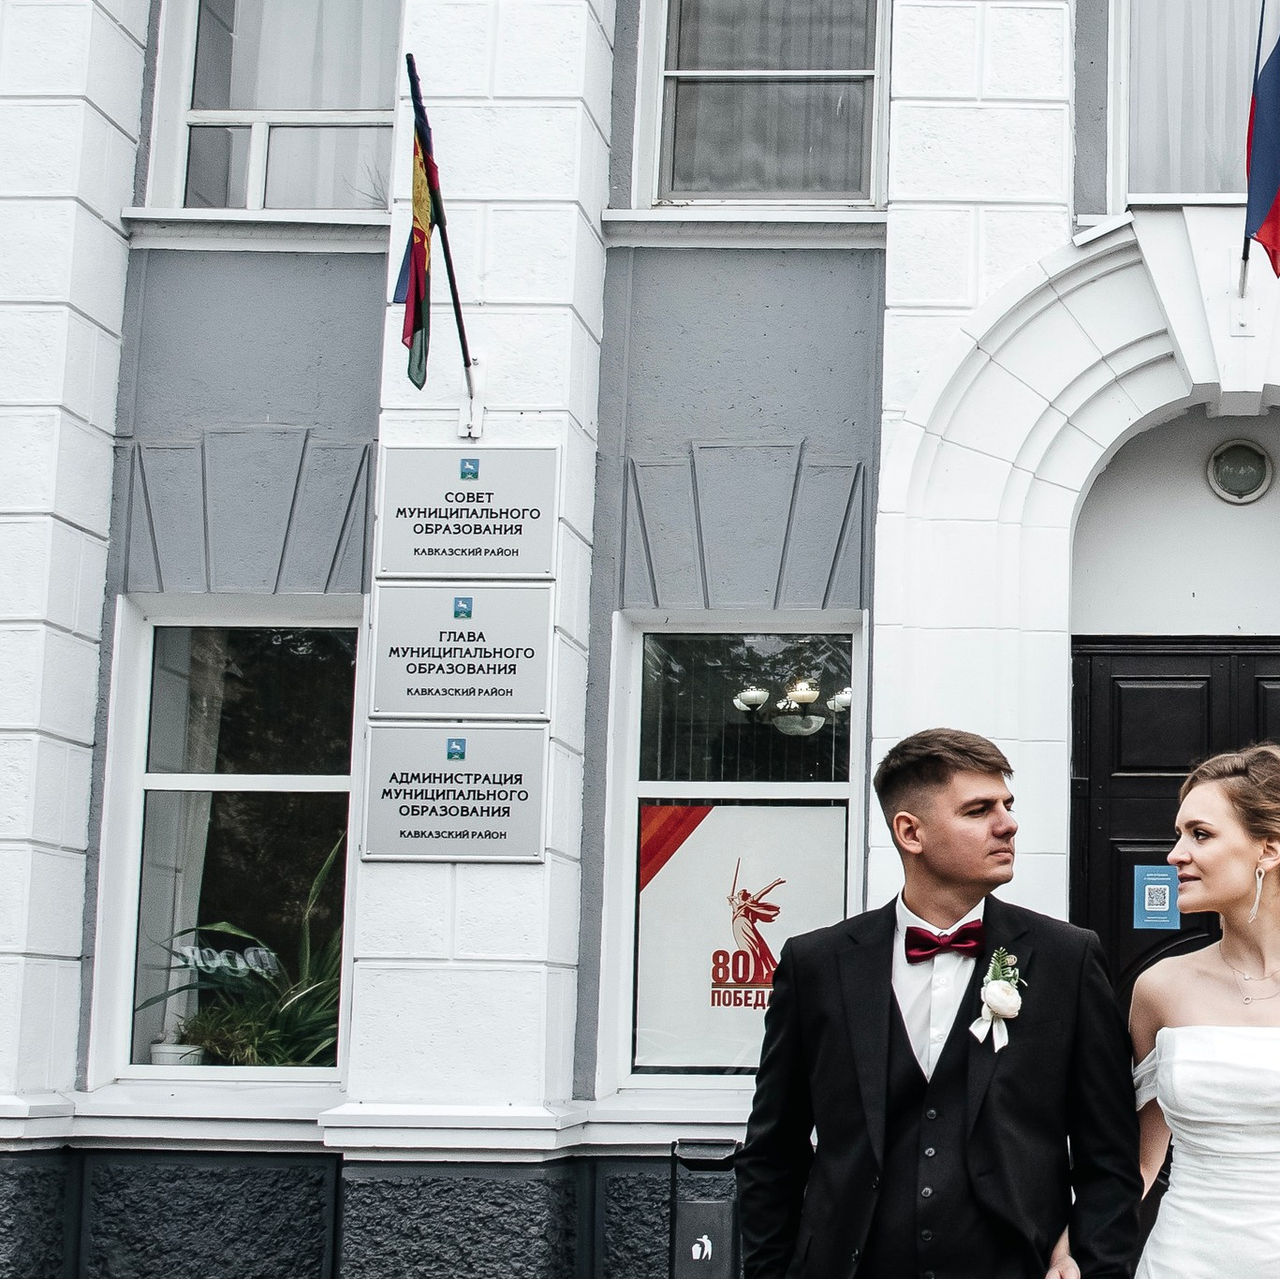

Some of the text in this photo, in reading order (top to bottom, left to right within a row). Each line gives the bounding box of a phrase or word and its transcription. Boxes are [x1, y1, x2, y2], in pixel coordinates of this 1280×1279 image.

[444, 491, 495, 504] СОВЕТ
[395, 507, 541, 520] МУНИЦИПАЛЬНОГО
[412, 523, 523, 536] ОБРАЗОВАНИЯ
[413, 546, 519, 557] КАВКАЗСКИЙ РАЙОН
[439, 631, 486, 643] ГЛАВА
[388, 646, 535, 660] МУНИЦИПАЛЬНОГО
[406, 662, 517, 675] ОБРАЗОВАНИЯ
[406, 686, 513, 697] КАВКАЗСКИЙ РАЙОН
[388, 772, 523, 787] АДМИНИСТРАЦИЯ
[380, 788, 529, 802] МУНИЦИПАЛЬНОГО
[398, 804, 511, 818] ОБРАЗОВАНИЯ
[399, 829, 507, 840] КАВКАЗСКИЙ РАЙОН
[711, 949, 751, 984] 80
